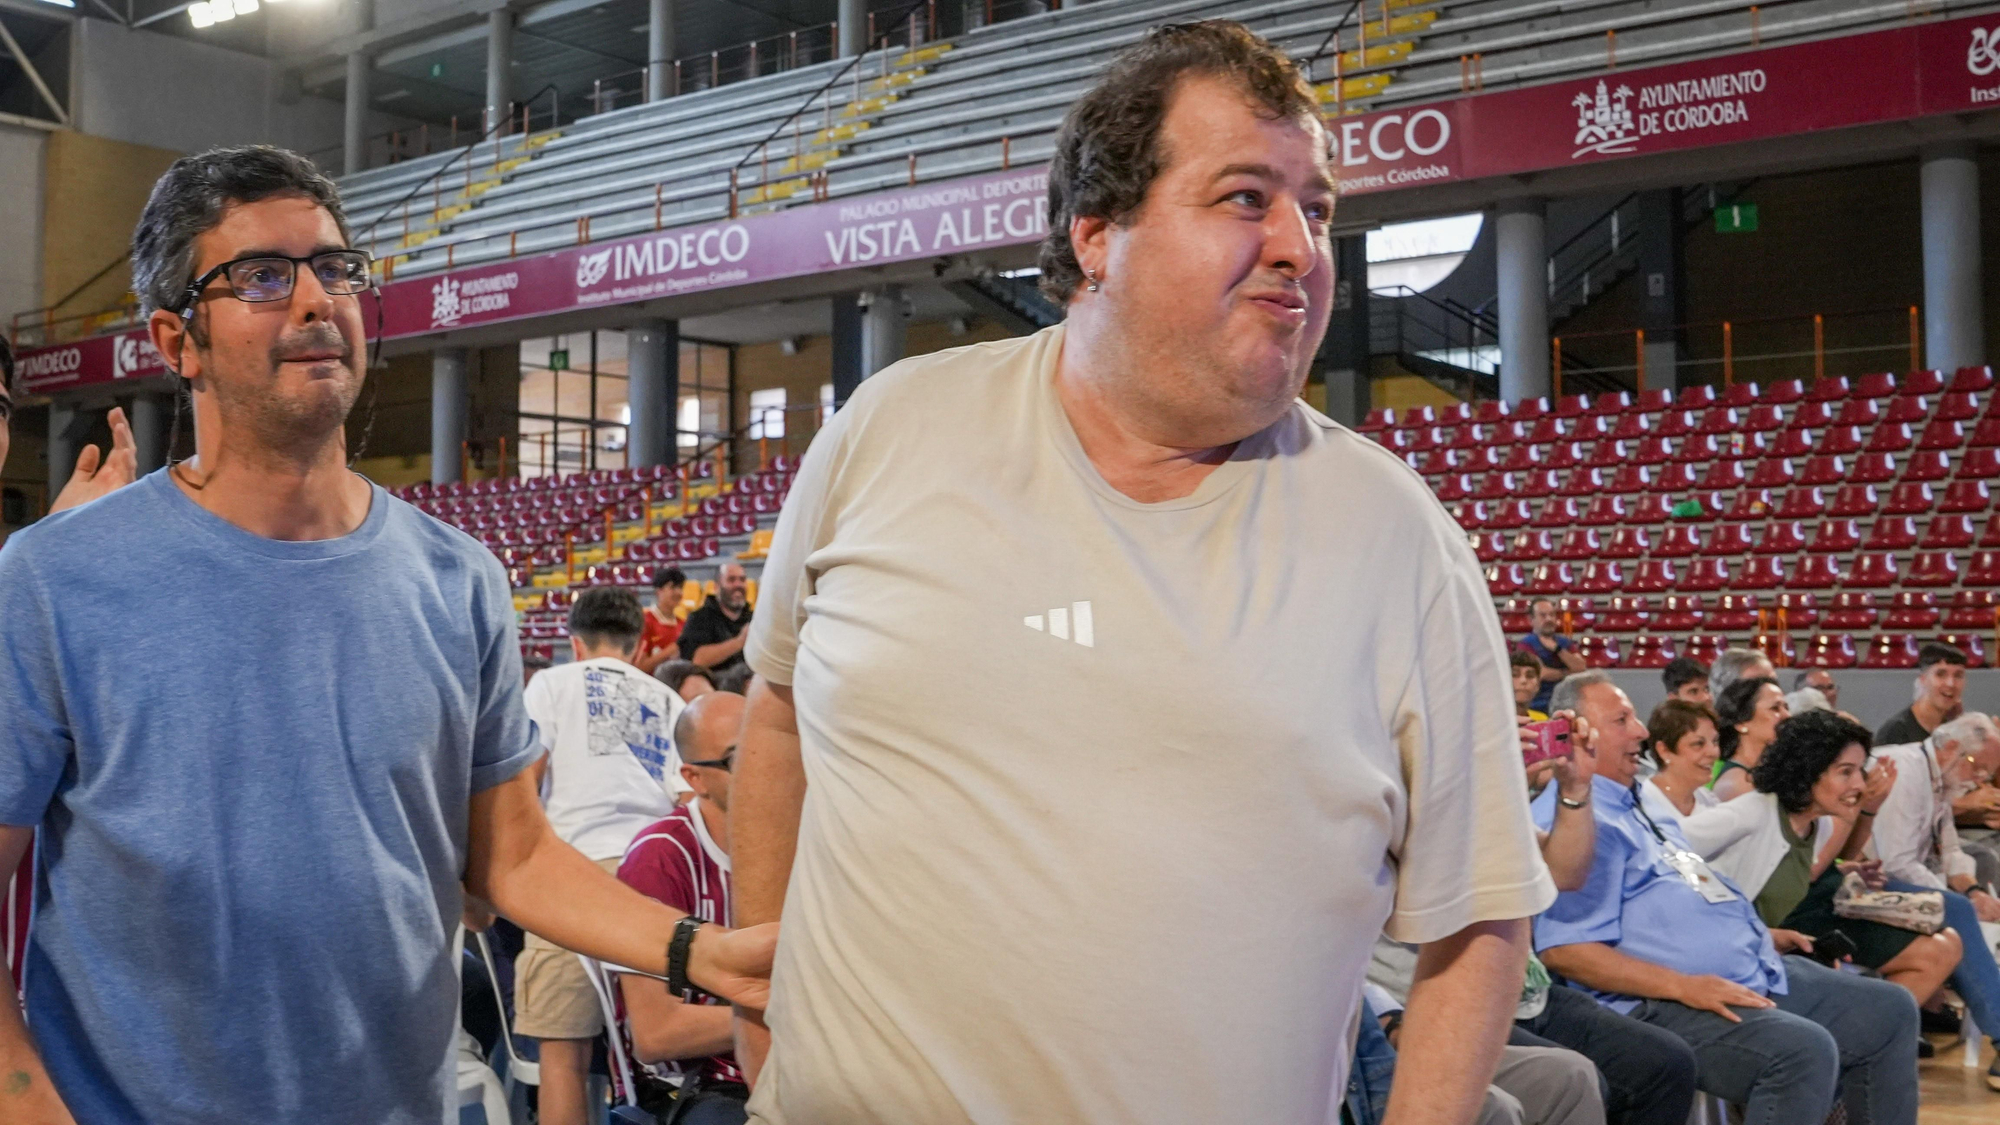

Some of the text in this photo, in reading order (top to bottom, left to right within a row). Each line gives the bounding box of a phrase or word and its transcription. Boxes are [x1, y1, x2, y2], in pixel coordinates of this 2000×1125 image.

[1638, 68, 1767, 110] AYUNTAMIENTO
[1970, 86, 2000, 103] Ins
[1639, 99, 1750, 136] DE CÓRDOBA
[839, 197, 899, 222] PALACIO
[901, 184, 979, 212] MUNICIPAL
[614, 224, 750, 281] IMDECO
[825, 218, 922, 265] VISTA
